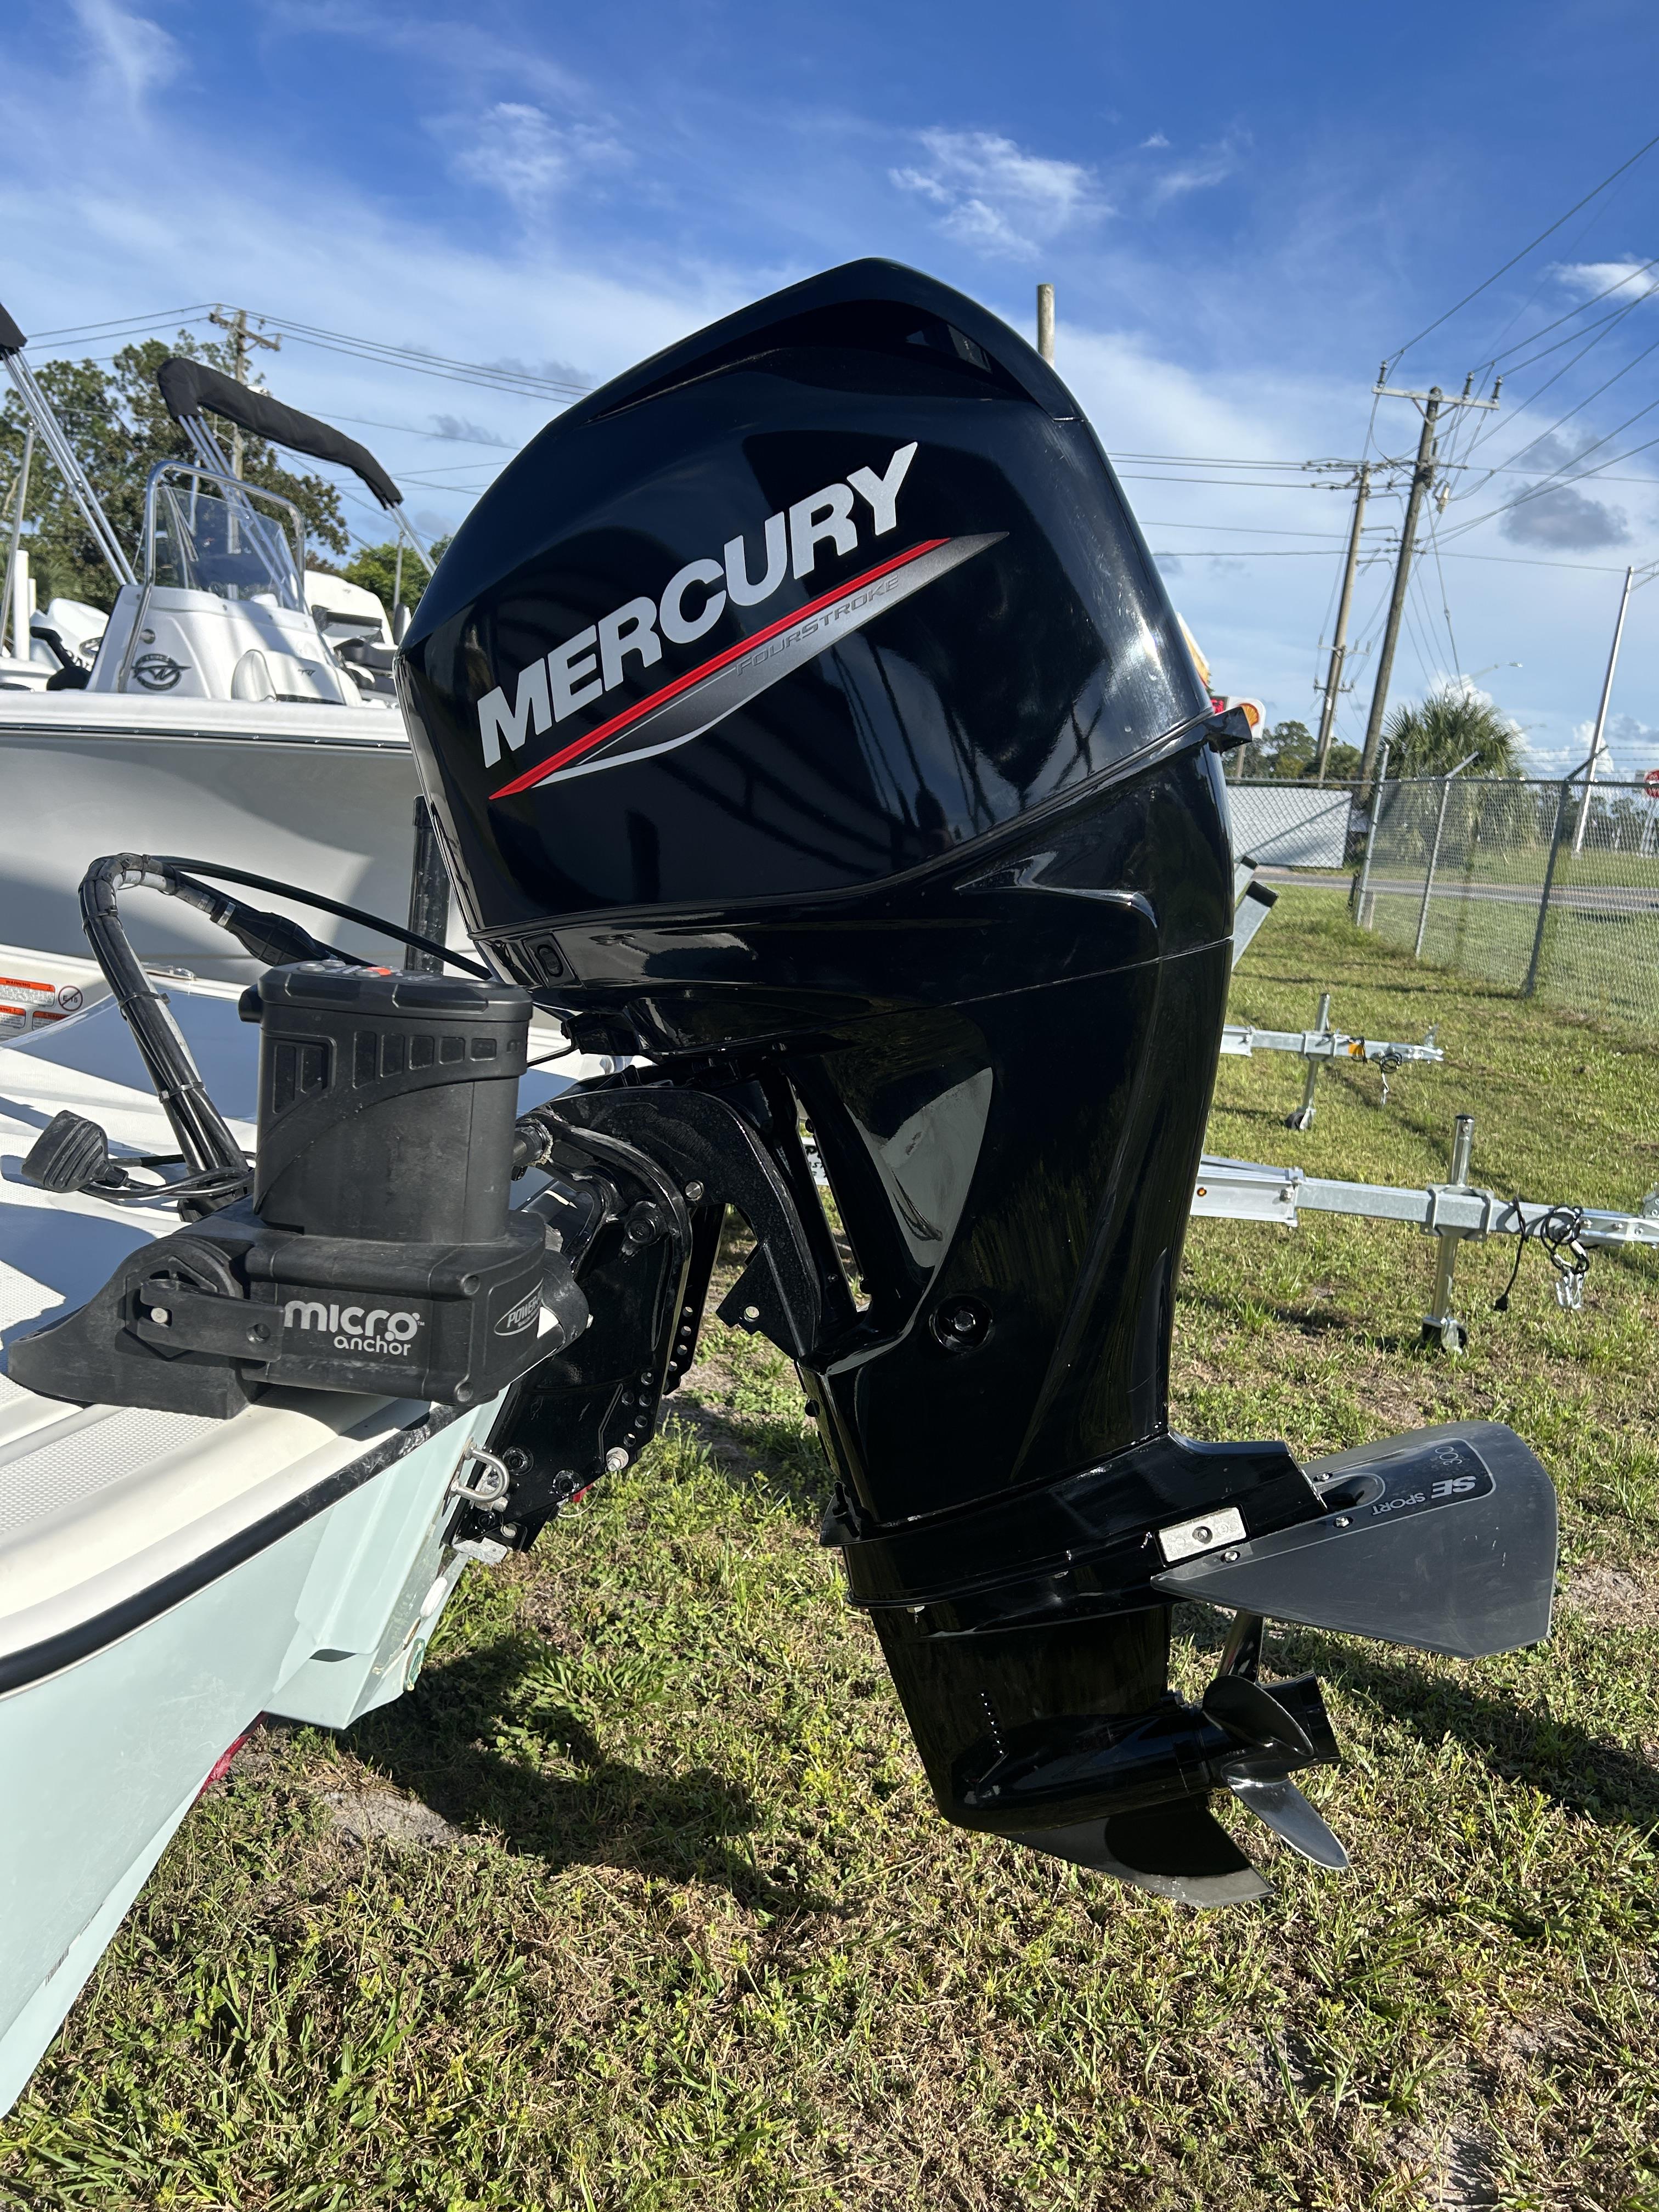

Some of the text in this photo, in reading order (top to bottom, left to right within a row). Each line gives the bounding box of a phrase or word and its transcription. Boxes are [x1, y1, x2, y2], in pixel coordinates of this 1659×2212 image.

[476, 441, 919, 769] MERCURY
[735, 574, 900, 676] FOURSTROKE
[284, 1300, 420, 1341] micro
[333, 1335, 411, 1356] anchor
[1434, 1446, 1463, 1466] 300
[1372, 1475, 1477, 1516] SE SPORT
